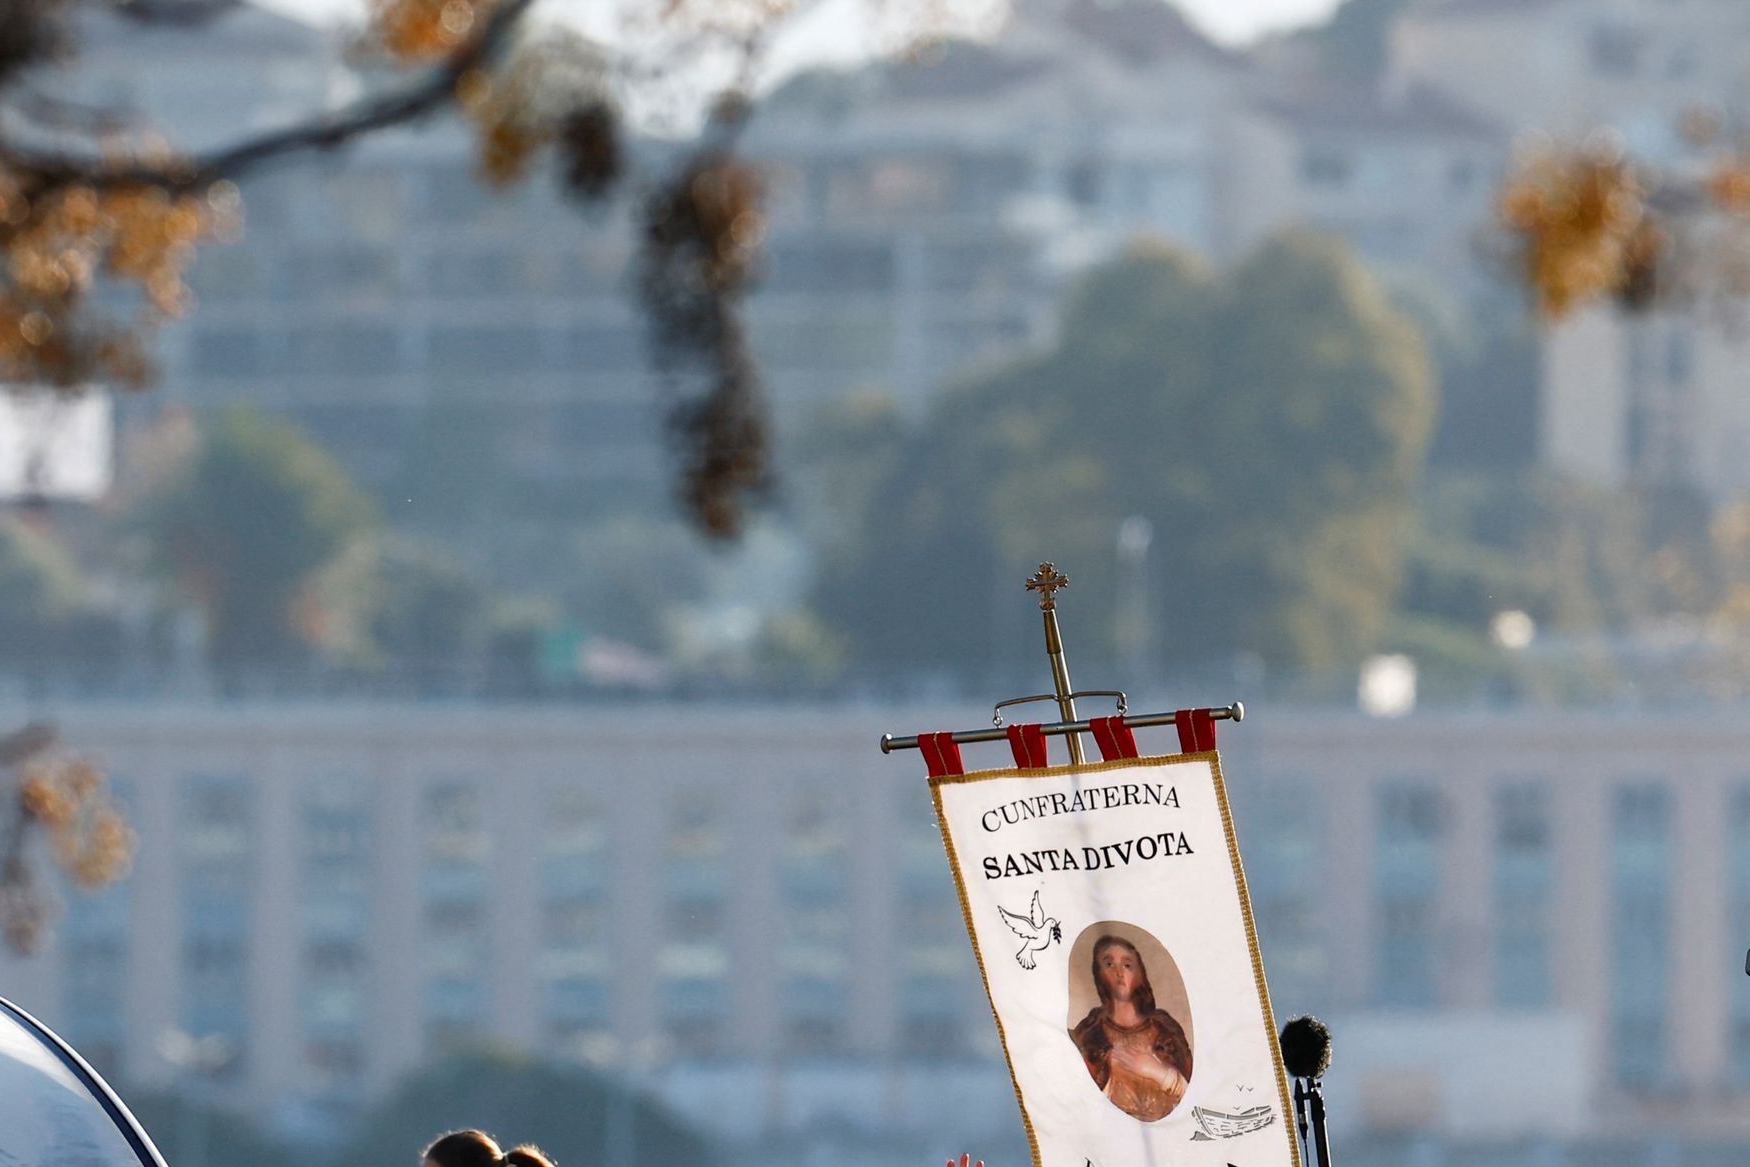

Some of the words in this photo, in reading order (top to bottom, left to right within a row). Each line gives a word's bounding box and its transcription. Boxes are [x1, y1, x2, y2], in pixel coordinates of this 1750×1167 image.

[981, 783, 1181, 833] CUNFRATERNA
[982, 847, 1080, 880] SANTA
[1081, 831, 1195, 871] DIVOTA
